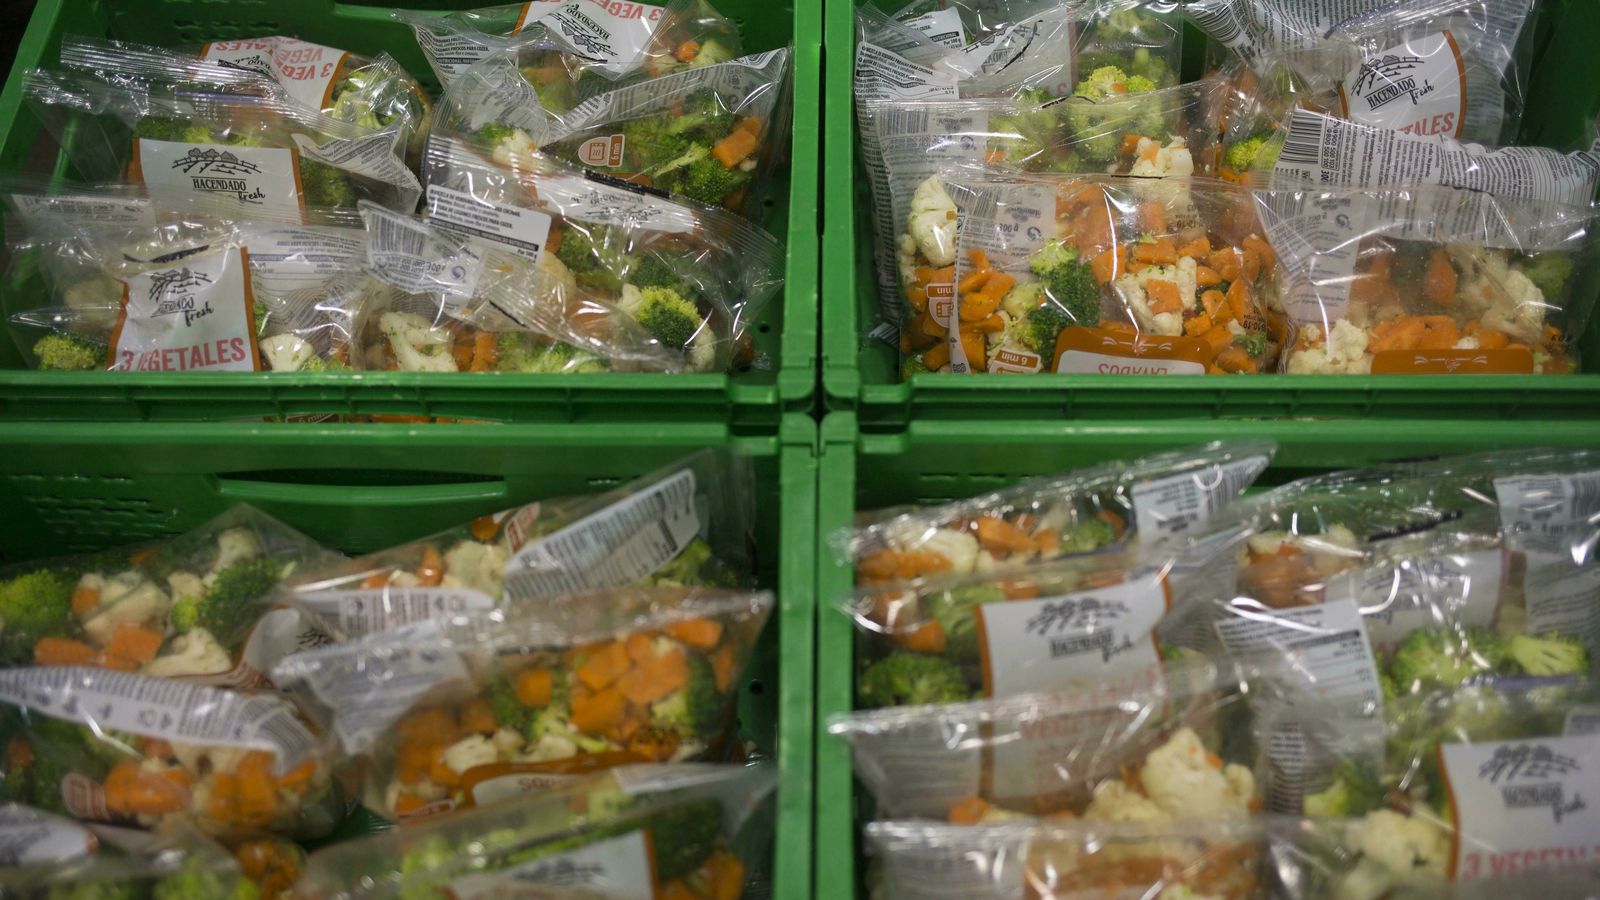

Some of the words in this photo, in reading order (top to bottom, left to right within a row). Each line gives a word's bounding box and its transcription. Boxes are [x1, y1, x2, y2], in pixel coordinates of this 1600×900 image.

[566, 7, 612, 41] HACENDADO
[1366, 77, 1416, 109] HACENDADO
[1409, 79, 1434, 106] fresh
[612, 143, 621, 155] min
[192, 178, 247, 192] HACENDADO
[184, 300, 215, 327] fresh
[120, 349, 135, 371] 3
[1001, 352, 1020, 363] min
[1021, 357, 1028, 365] 6
